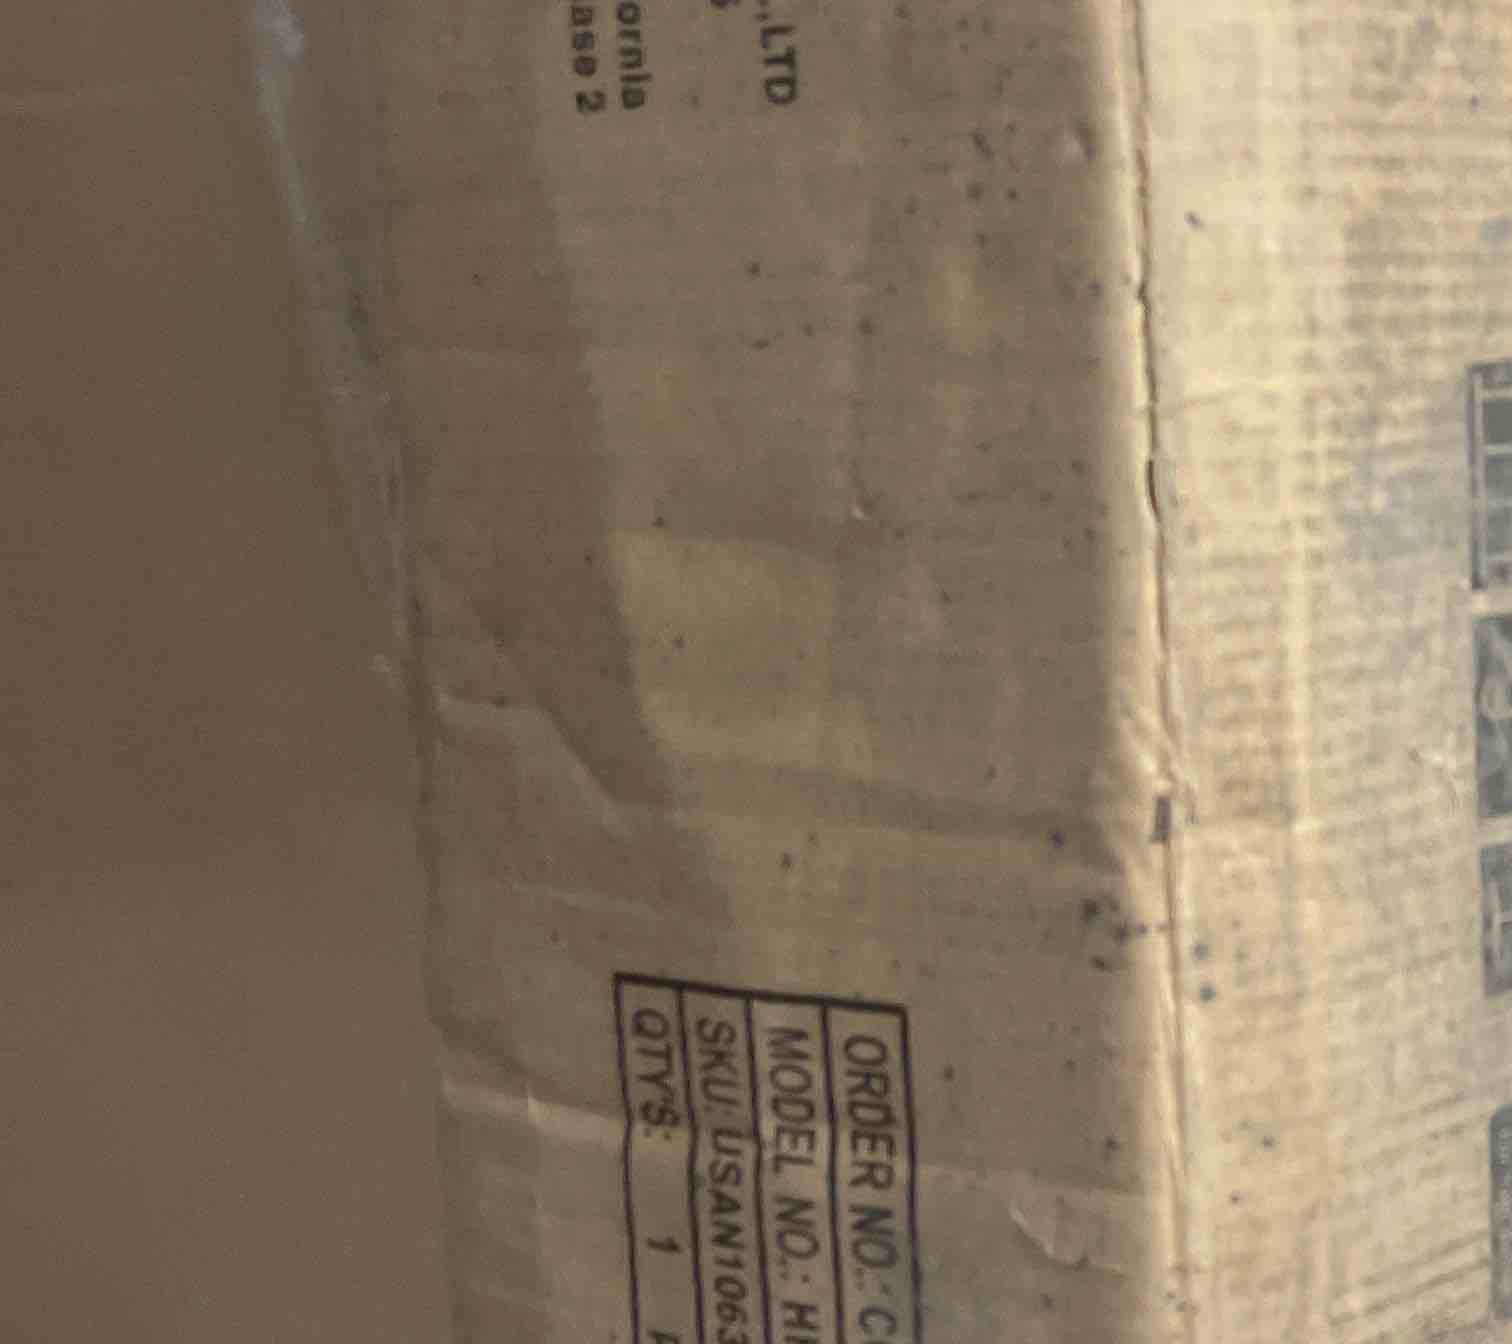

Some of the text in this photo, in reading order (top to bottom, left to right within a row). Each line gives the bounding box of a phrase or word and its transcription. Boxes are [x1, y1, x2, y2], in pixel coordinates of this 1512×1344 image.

[575, 92, 605, 114] 2
[696, 1017, 744, 1116] SKU:
[768, 1026, 816, 1175] MODEL
[842, 1033, 894, 1187] ORDER
[647, 1234, 682, 1255] 1
